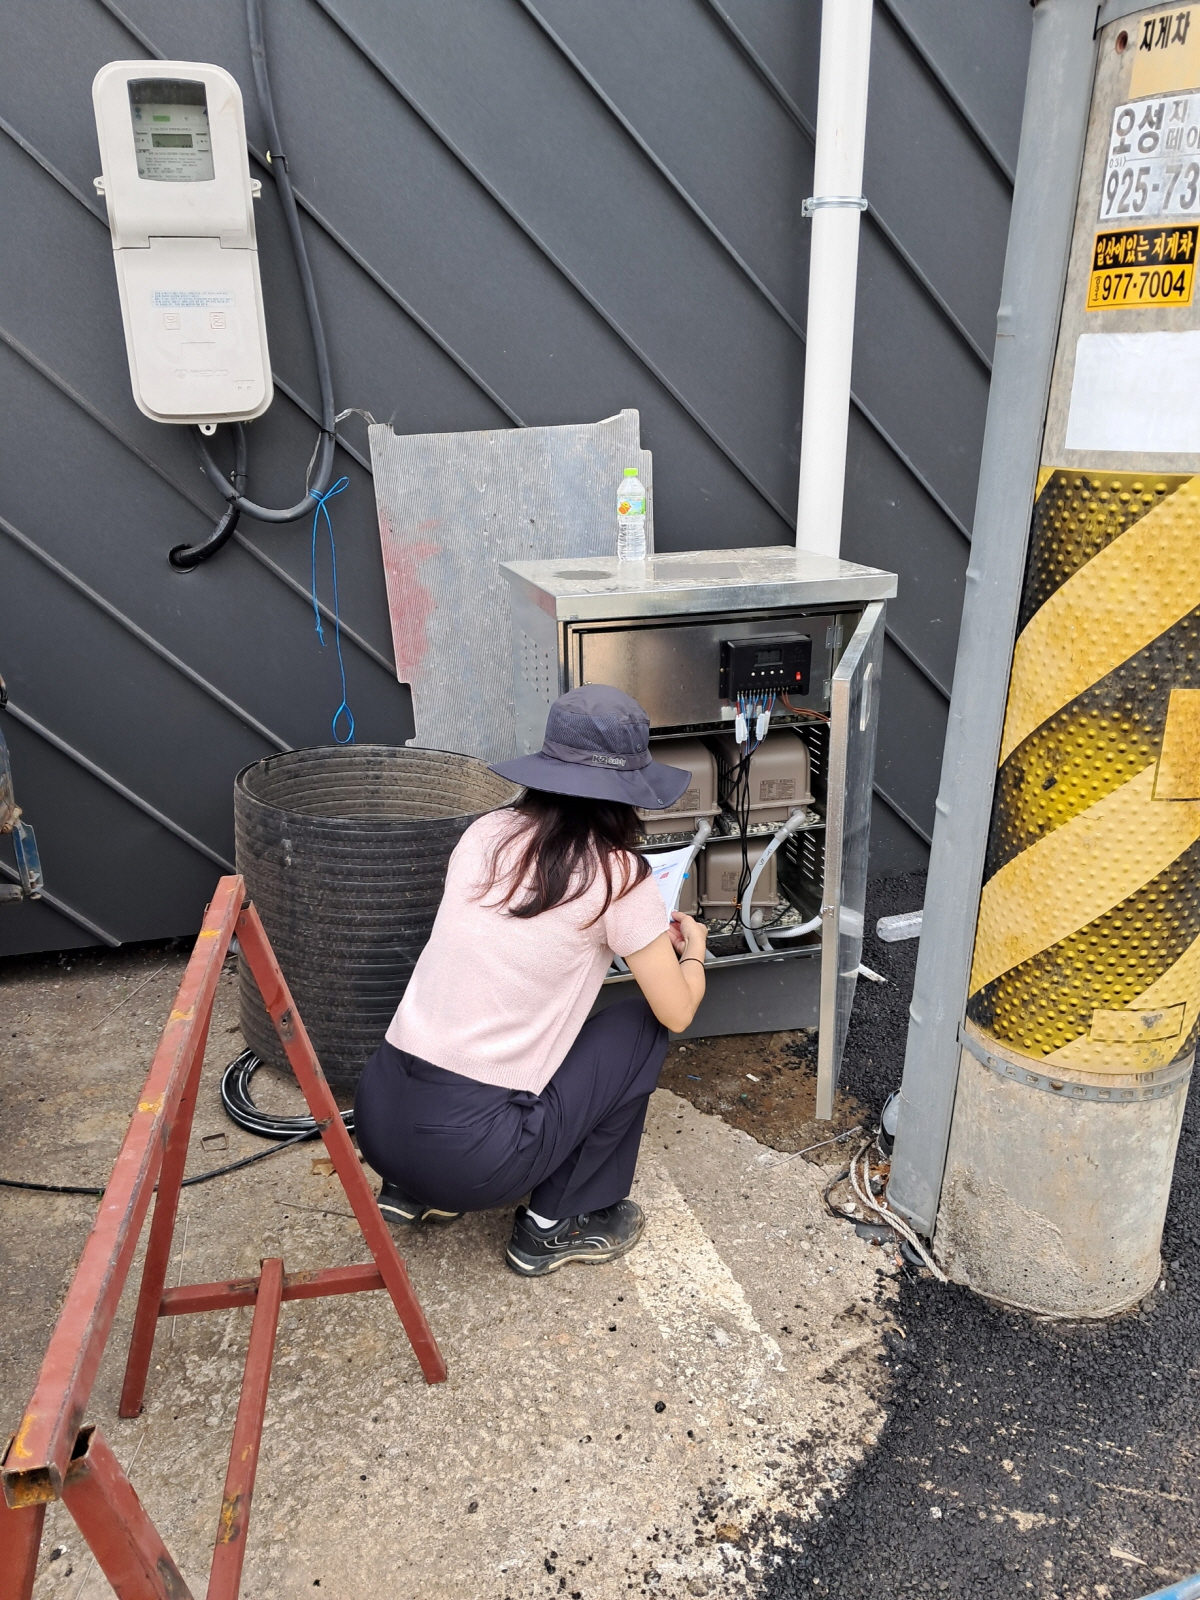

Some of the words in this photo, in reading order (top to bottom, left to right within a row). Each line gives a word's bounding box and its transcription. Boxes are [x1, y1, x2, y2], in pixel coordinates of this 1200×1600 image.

[1139, 10, 1191, 52] 지게차
[1112, 102, 1166, 156] 오성
[1105, 161, 1200, 216] 925-73
[1151, 230, 1194, 262] 지게차
